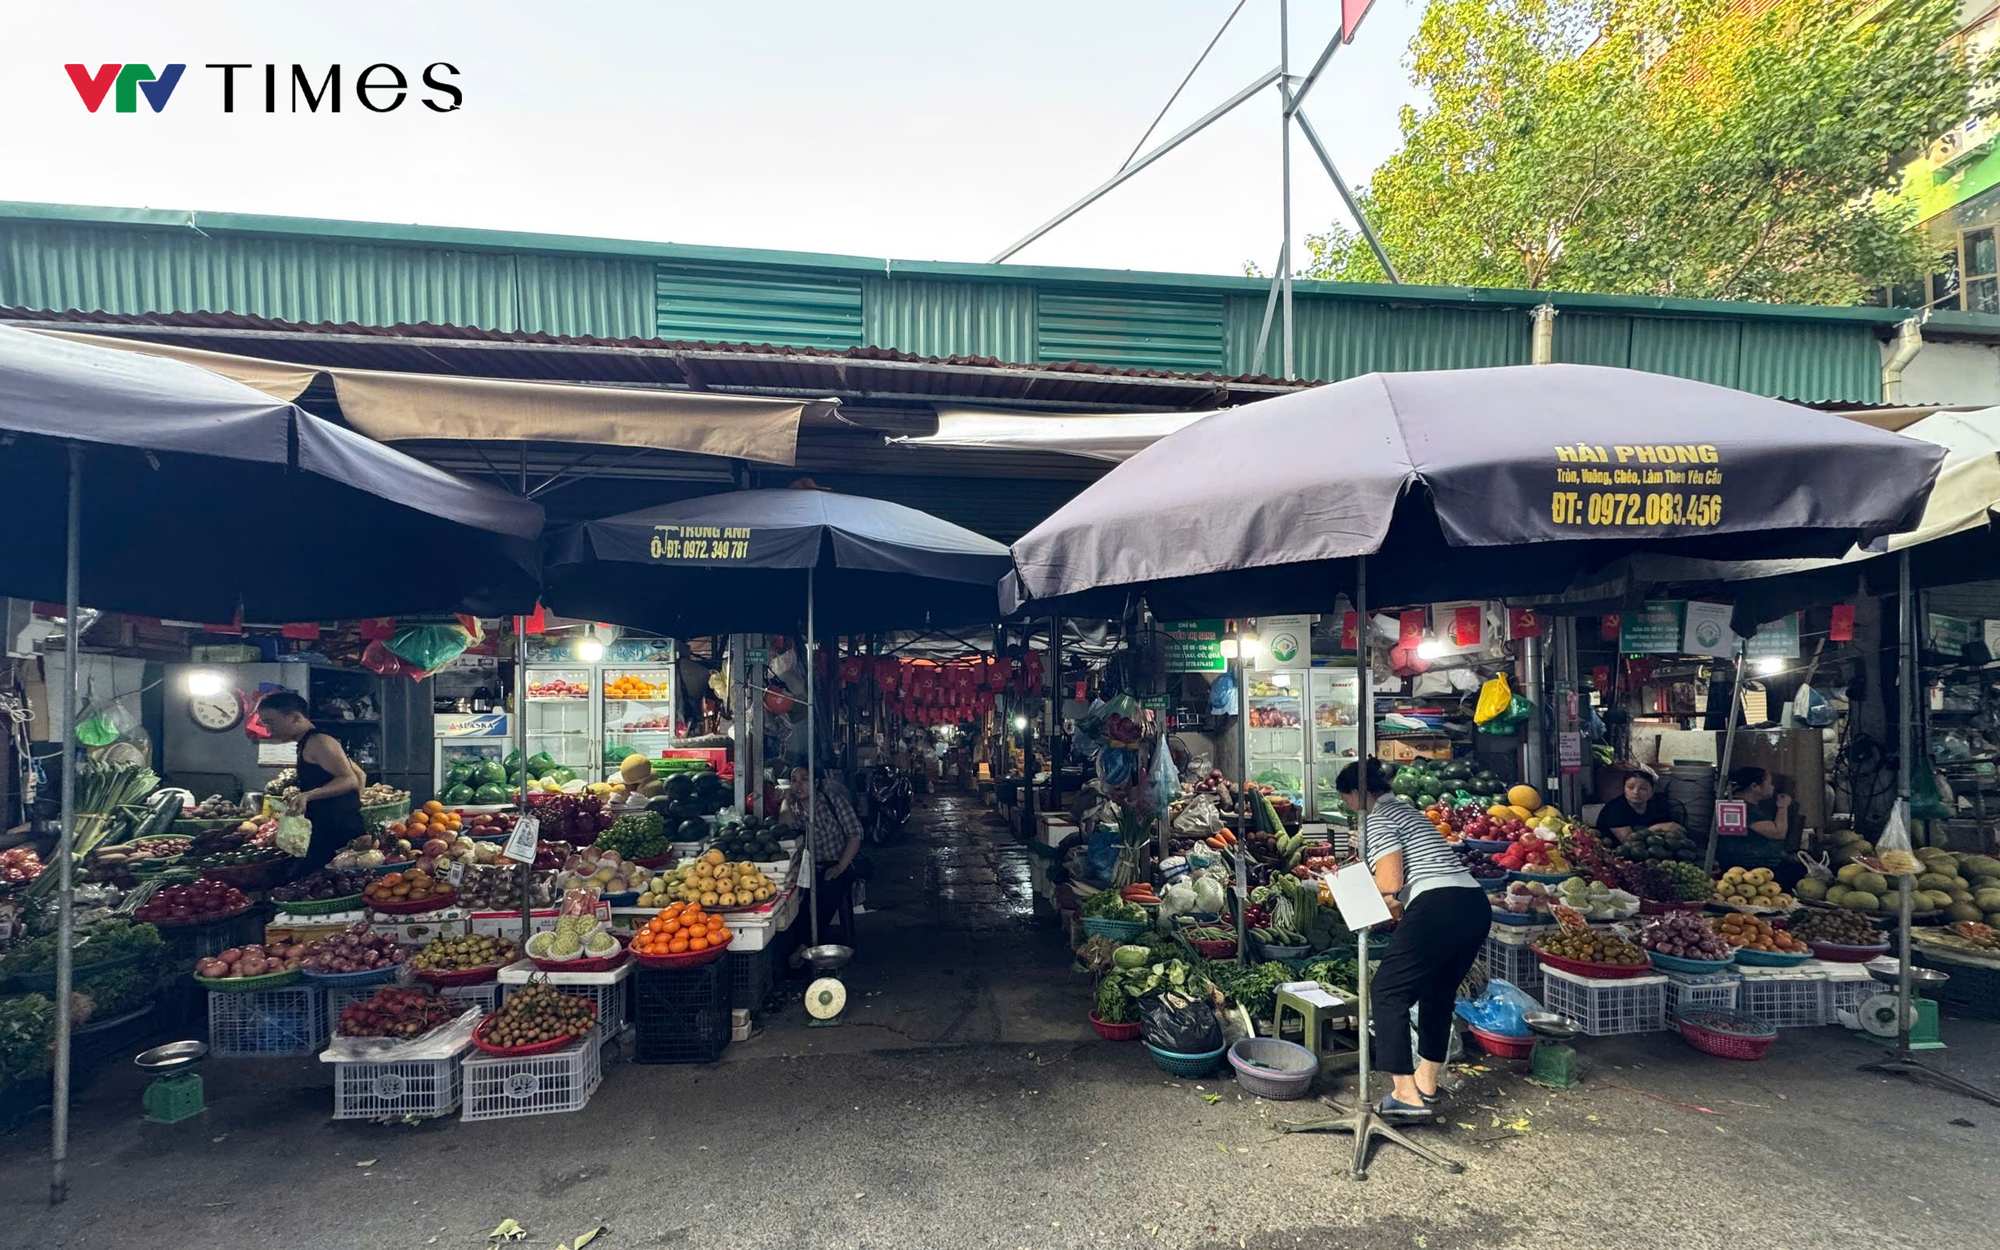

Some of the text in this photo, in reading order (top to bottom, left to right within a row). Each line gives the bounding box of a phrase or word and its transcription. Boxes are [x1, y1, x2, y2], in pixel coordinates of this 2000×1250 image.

[1554, 442, 1719, 464] HẢI PHONG
[1557, 468, 1580, 484] Tròn,
[1614, 469, 1641, 485] Chéo,
[1642, 468, 1663, 484] Làm
[1665, 469, 1686, 484] Theo
[1552, 492, 1722, 527] ĐT: 0972.083.456
[666, 540, 748, 559] ĐT: 0972. 349 781
